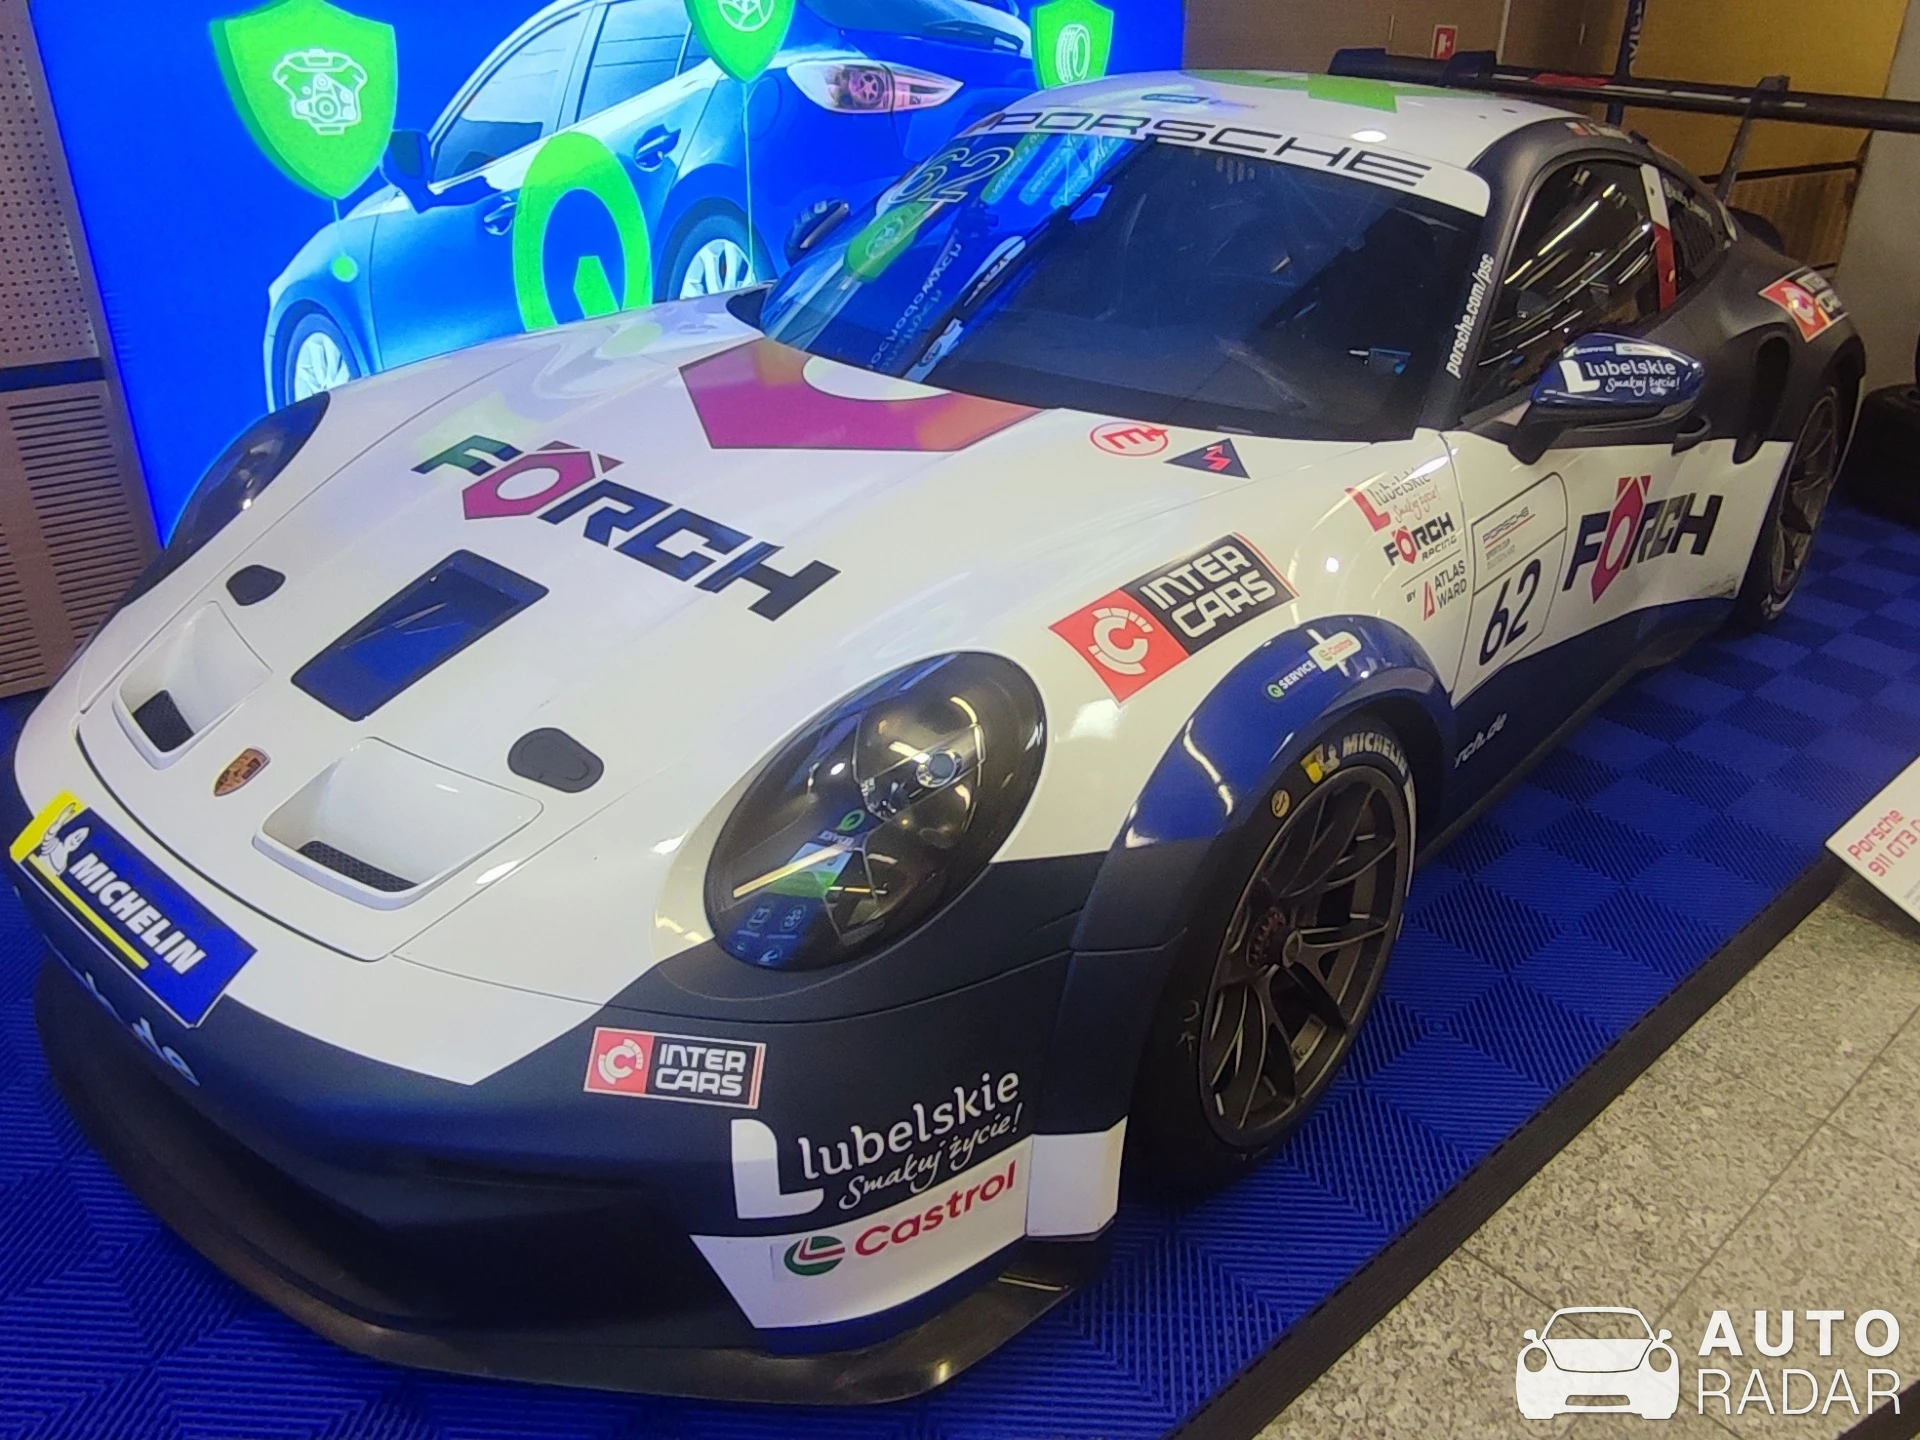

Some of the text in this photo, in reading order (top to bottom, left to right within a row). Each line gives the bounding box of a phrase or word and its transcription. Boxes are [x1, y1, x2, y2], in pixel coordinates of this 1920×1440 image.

[886, 146, 1015, 204] 62
[987, 111, 1432, 187] PORSCHE
[1445, 253, 1495, 379] porsche.com/psc
[410, 434, 842, 622] FÖRCH
[1383, 511, 1455, 566] FÖRCH
[1482, 506, 1530, 544] PORSCHE
[1562, 475, 1723, 604] FÖRCH
[1139, 545, 1252, 611] INTER
[1171, 569, 1276, 638] CARS
[1406, 589, 1417, 603] BY
[1434, 559, 1466, 591] ATLAS
[1436, 578, 1467, 609] WARD
[1479, 558, 1541, 666] 62
[1278, 659, 1317, 690] SERVICE
[1847, 810, 1904, 861] Porsche
[1867, 829, 1918, 877] 911 GT3
[68, 852, 207, 975] MICHELIN
[655, 1067, 743, 1097] CARS
[658, 1043, 747, 1073] INTER
[838, 1102, 1023, 1210] Smakuj życie!
[855, 1160, 1017, 1256] Castrol
